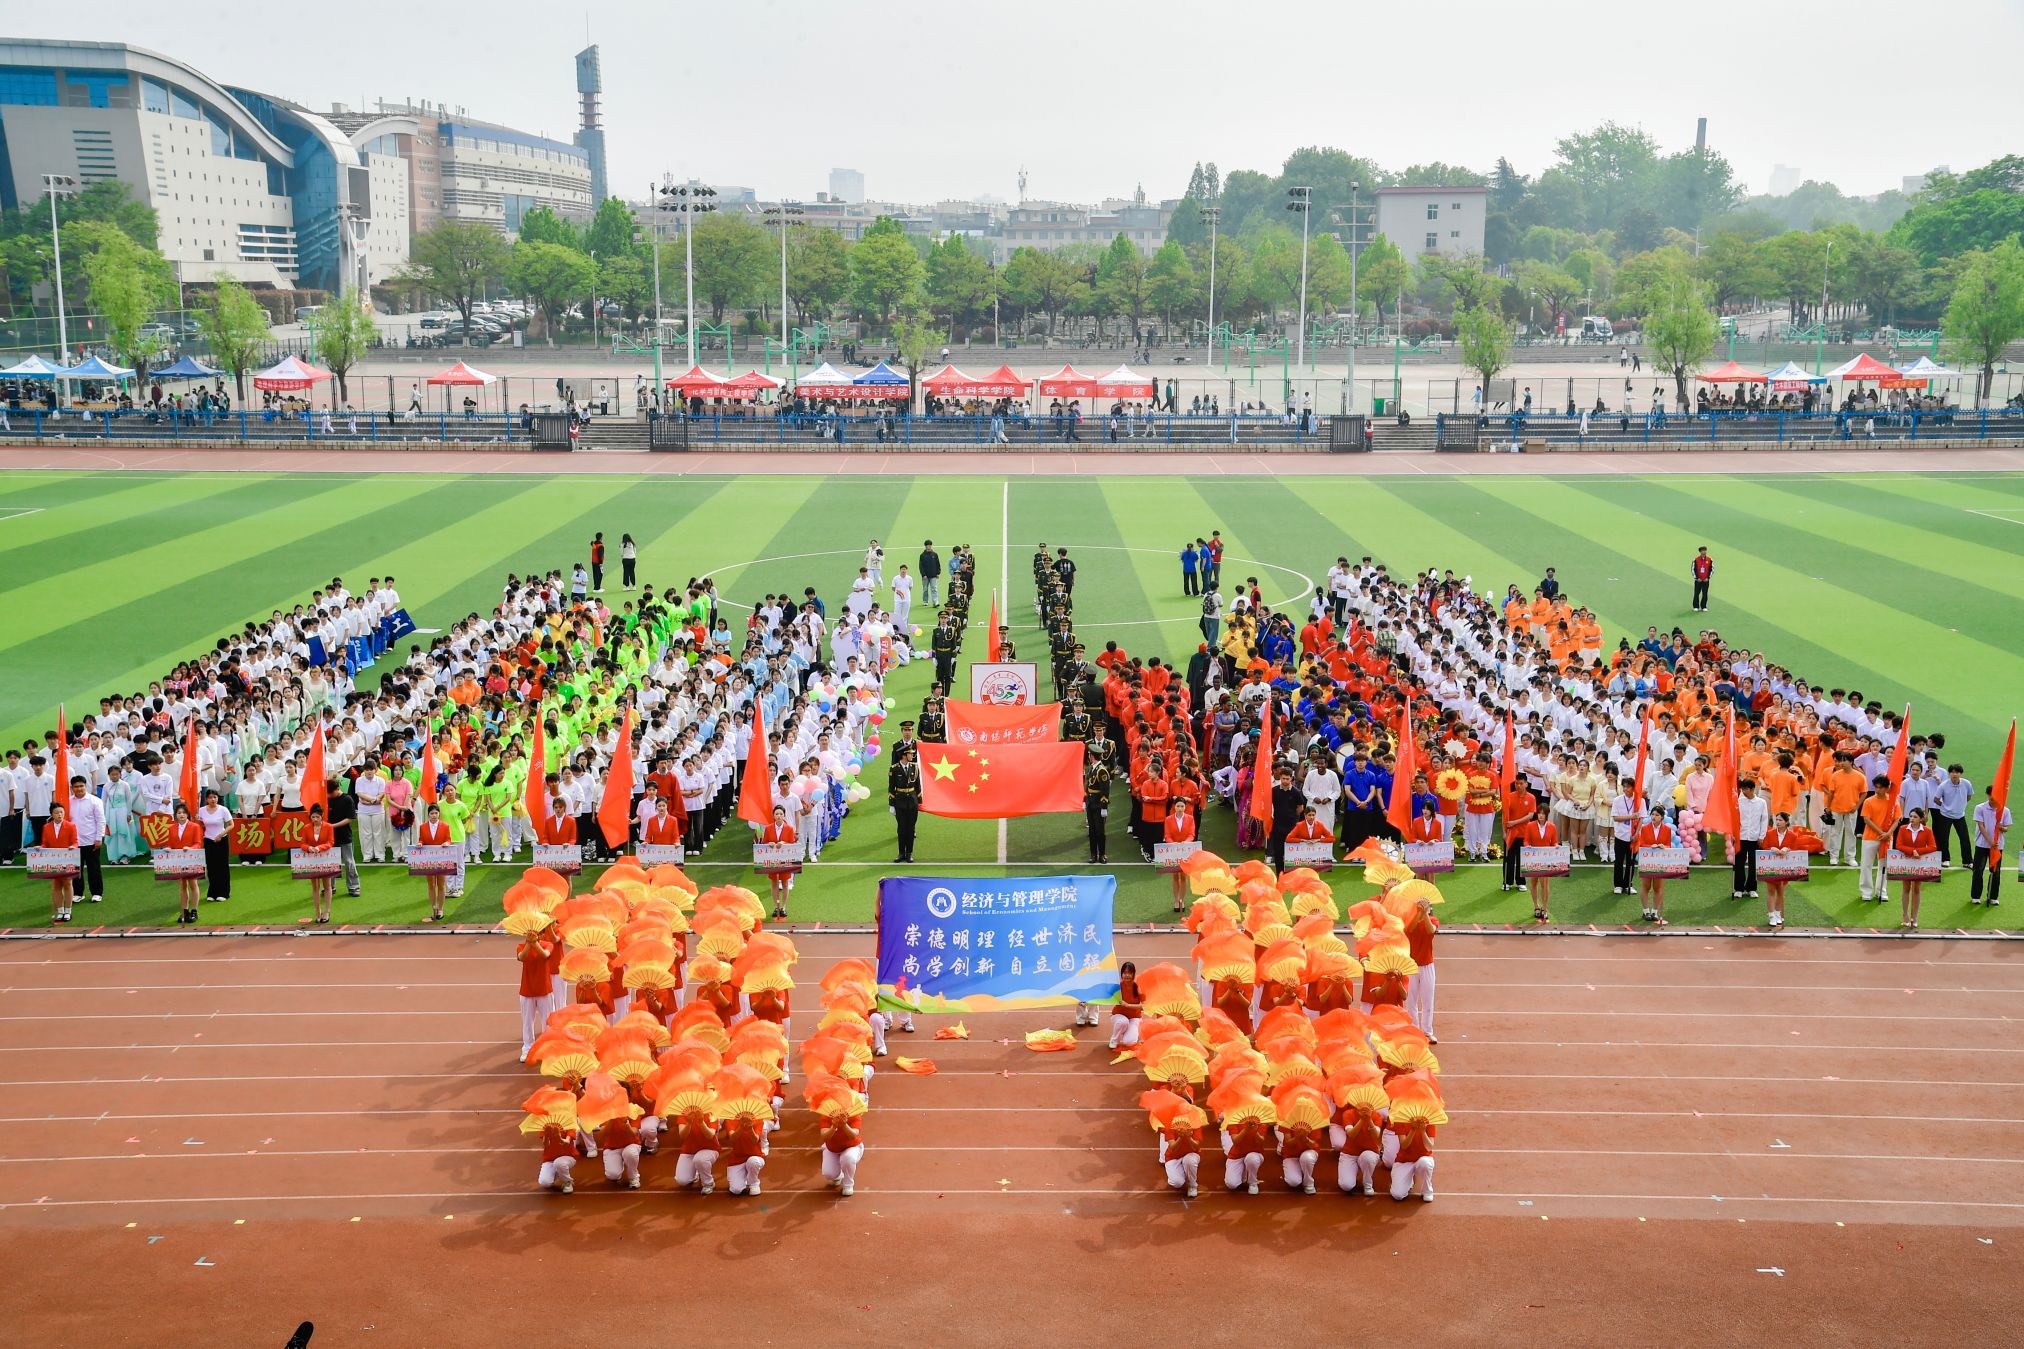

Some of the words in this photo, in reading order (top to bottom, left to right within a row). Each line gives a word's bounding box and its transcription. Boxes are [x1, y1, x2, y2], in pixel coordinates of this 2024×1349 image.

[799, 387, 909, 397] 美术与艺术设计学院
[940, 386, 1016, 395] 生命科学学院
[1045, 386, 1145, 396] 体育学院
[236, 822, 265, 850] 场
[280, 817, 305, 843] 化
[961, 885, 1079, 909] 经济与管理学院
[904, 923, 996, 951] 崇德明理
[1007, 922, 1102, 949] 经世济民
[902, 954, 996, 978] 尚学创新
